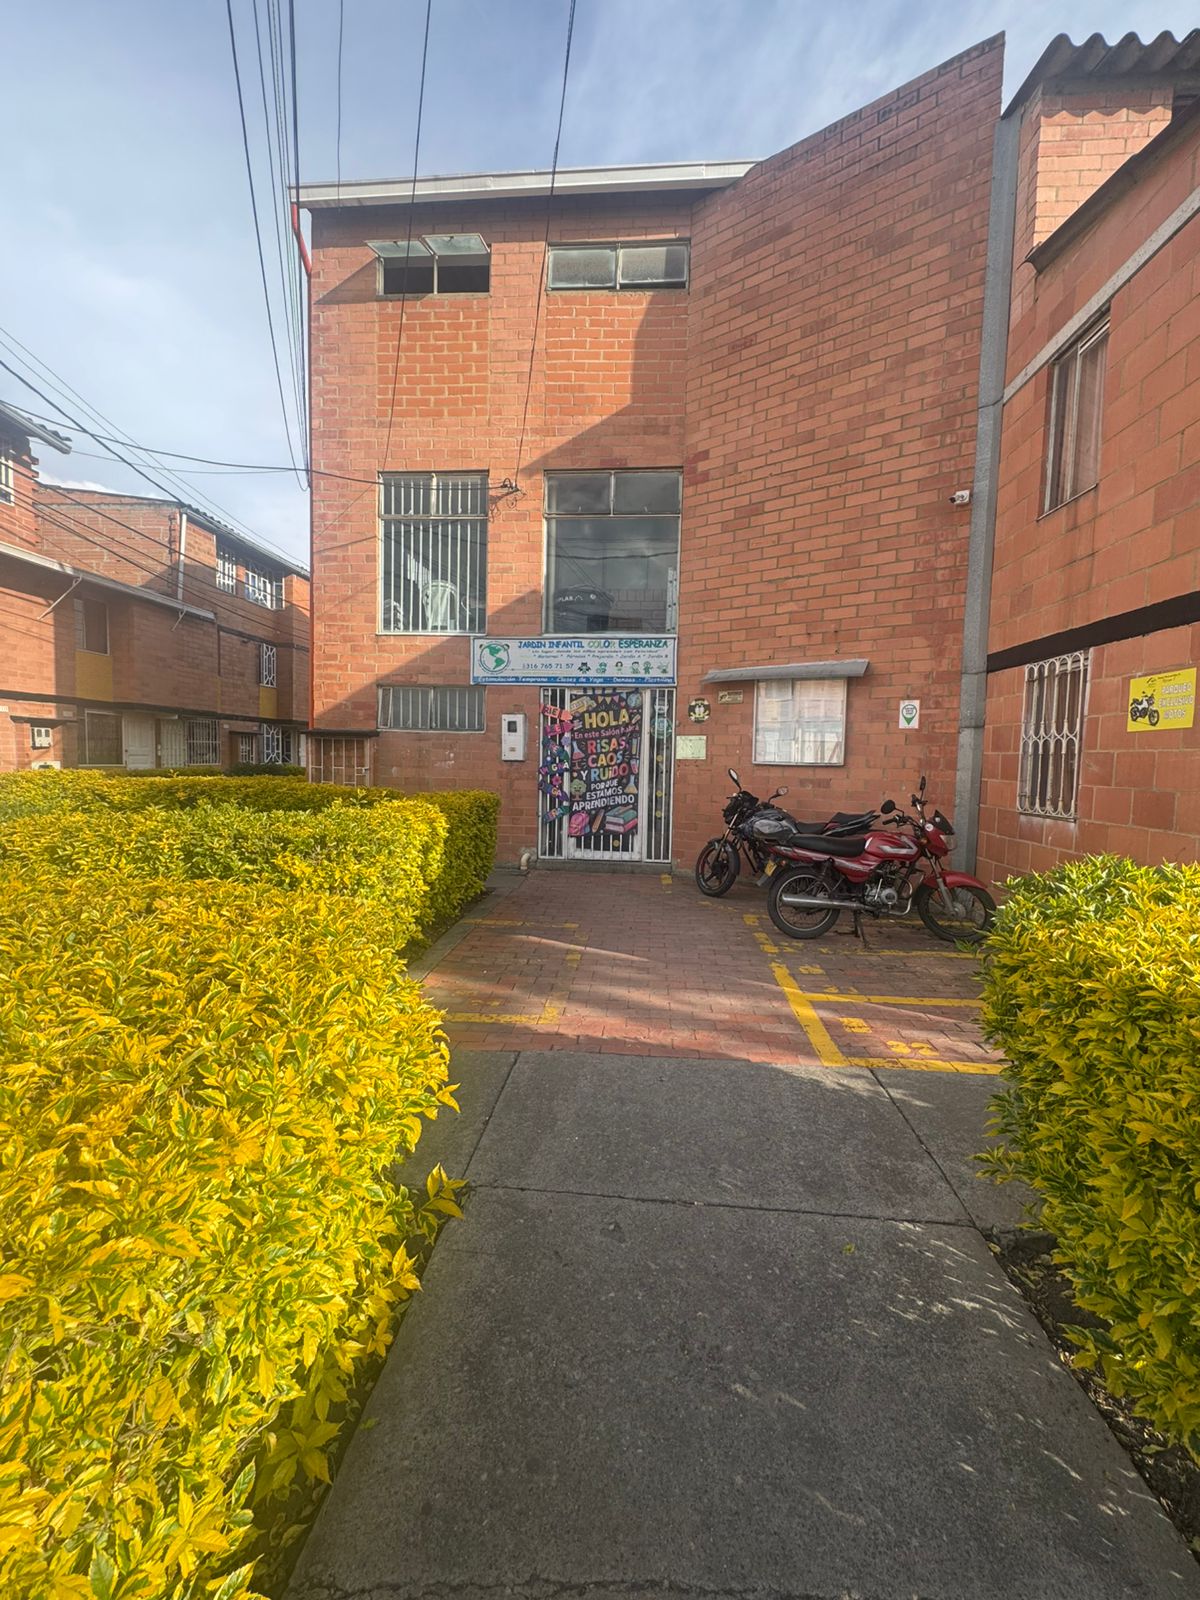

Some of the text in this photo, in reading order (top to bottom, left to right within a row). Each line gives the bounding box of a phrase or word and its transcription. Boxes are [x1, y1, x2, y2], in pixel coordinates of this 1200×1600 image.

[518, 640, 668, 649] JARDIN INFANTIL COLOR ESPERANZA
[584, 709, 630, 729] HOLA
[574, 731, 583, 739] En
[584, 731, 600, 739] este
[600, 728, 620, 737] Salón
[588, 751, 623, 768] CAOS
[580, 770, 588, 780] Y
[590, 779, 619, 790] PORQUE
[586, 786, 623, 800] ESTAMOS
[572, 794, 635, 811] APRENDIENDO
